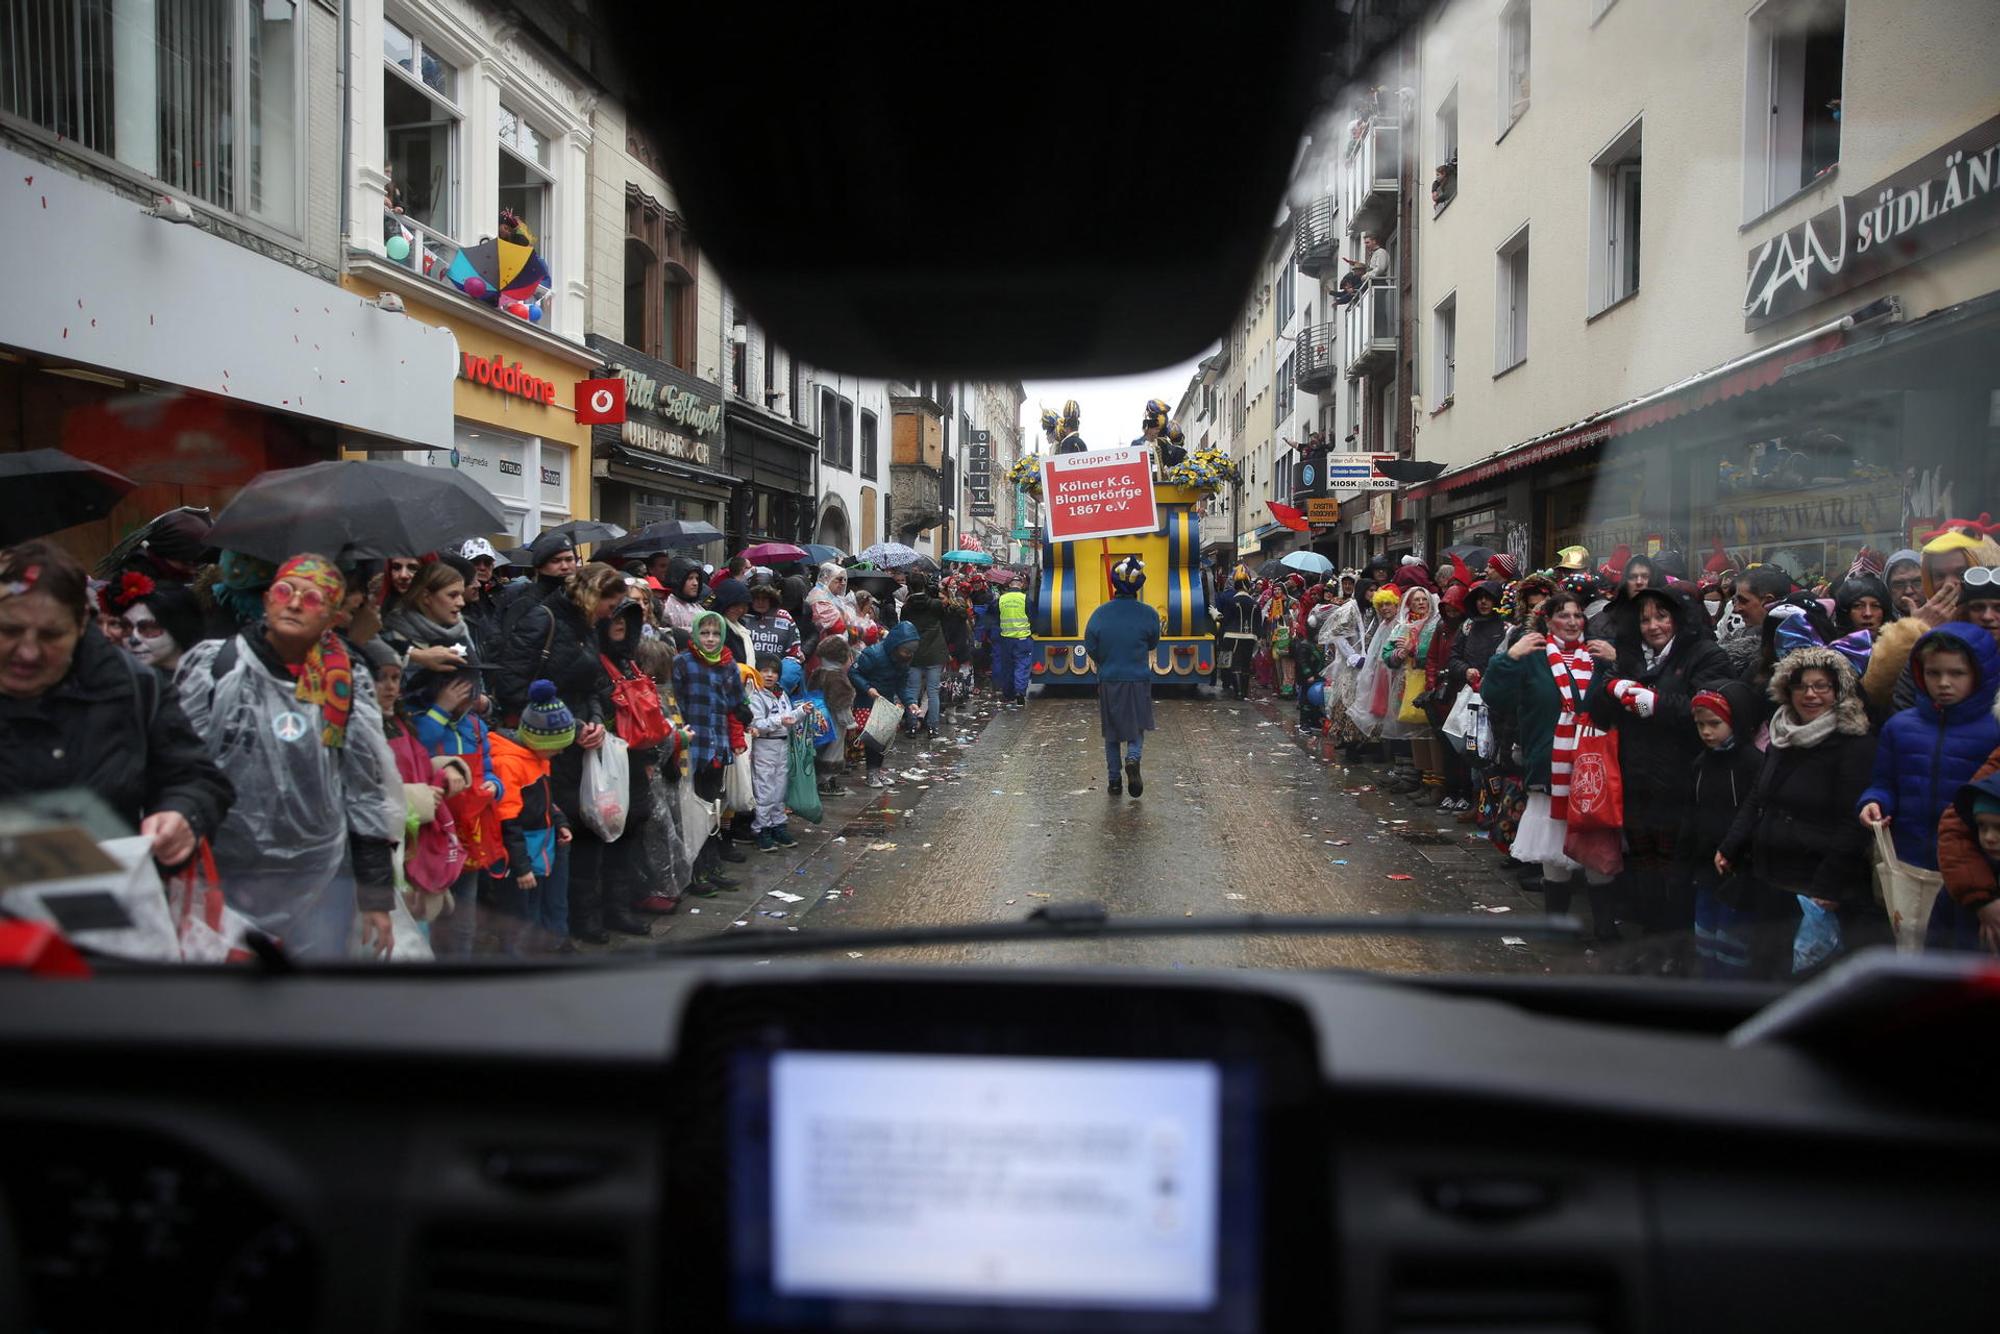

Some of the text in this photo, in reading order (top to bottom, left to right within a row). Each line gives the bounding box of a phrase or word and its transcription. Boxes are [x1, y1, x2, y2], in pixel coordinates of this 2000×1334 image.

[463, 352, 556, 406] vodafone
[1068, 451, 1129, 467] Gruppe 19
[1059, 475, 1135, 492] Kölner K.G.
[1055, 487, 1142, 505] Blomekörfge
[1069, 501, 1130, 516] 1867 e.V.
[751, 629, 779, 643] hein
[753, 641, 784, 654] ergie
